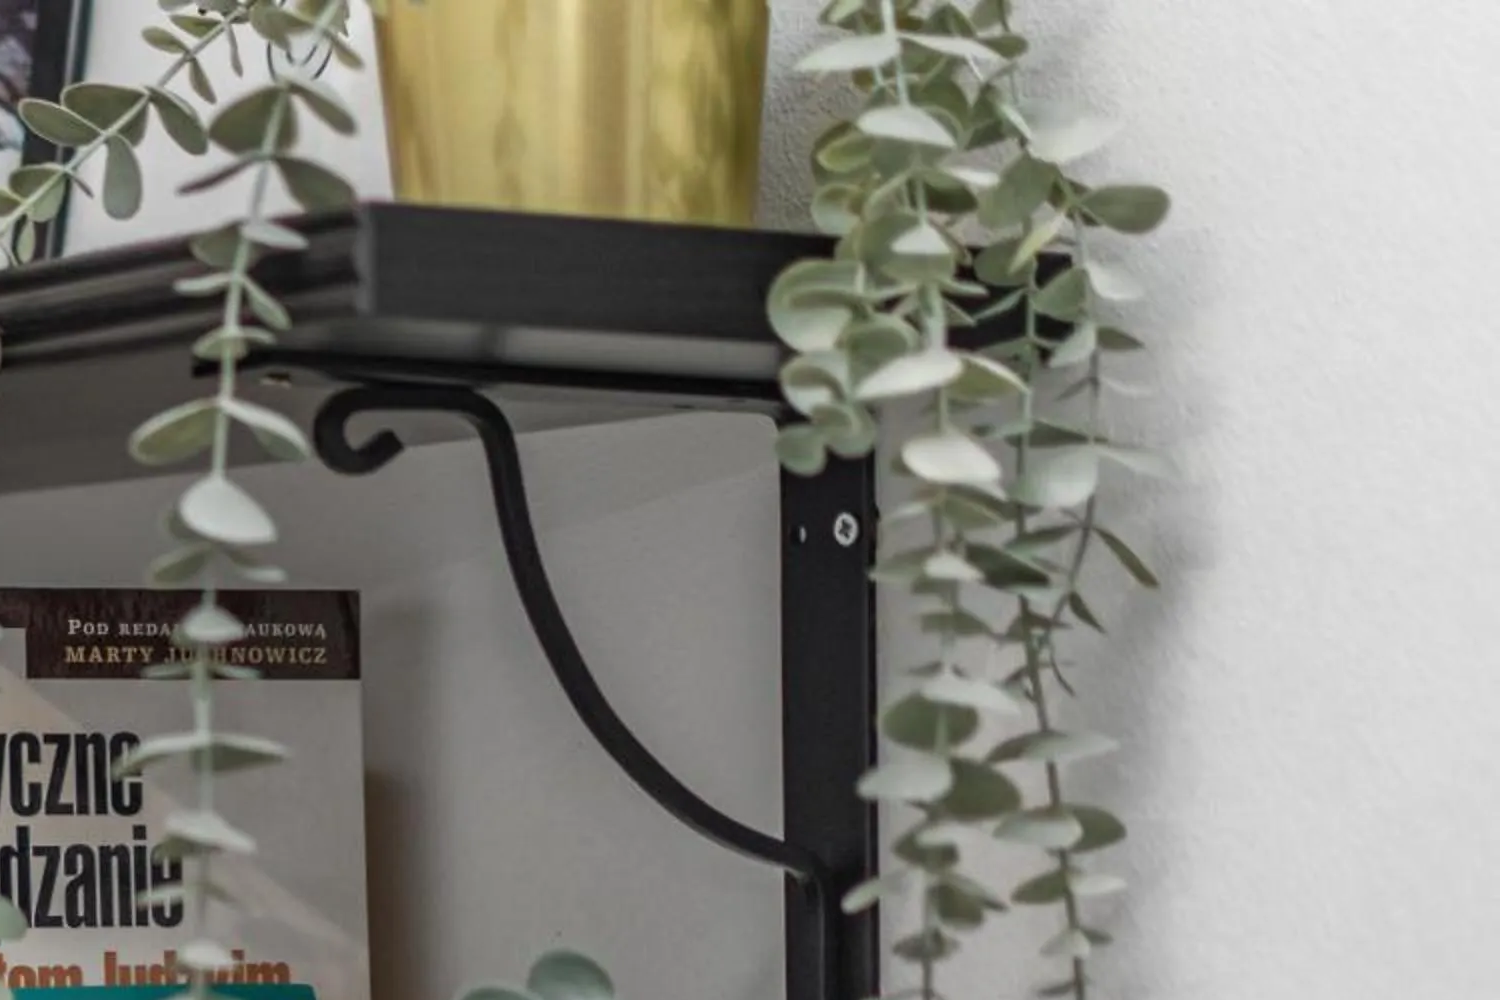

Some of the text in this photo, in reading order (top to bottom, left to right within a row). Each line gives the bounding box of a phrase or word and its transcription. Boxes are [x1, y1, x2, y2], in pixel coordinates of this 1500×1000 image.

[237, 622, 328, 640] AUKOWĄ
[65, 646, 328, 665] MARTY JUHNOWICZ
